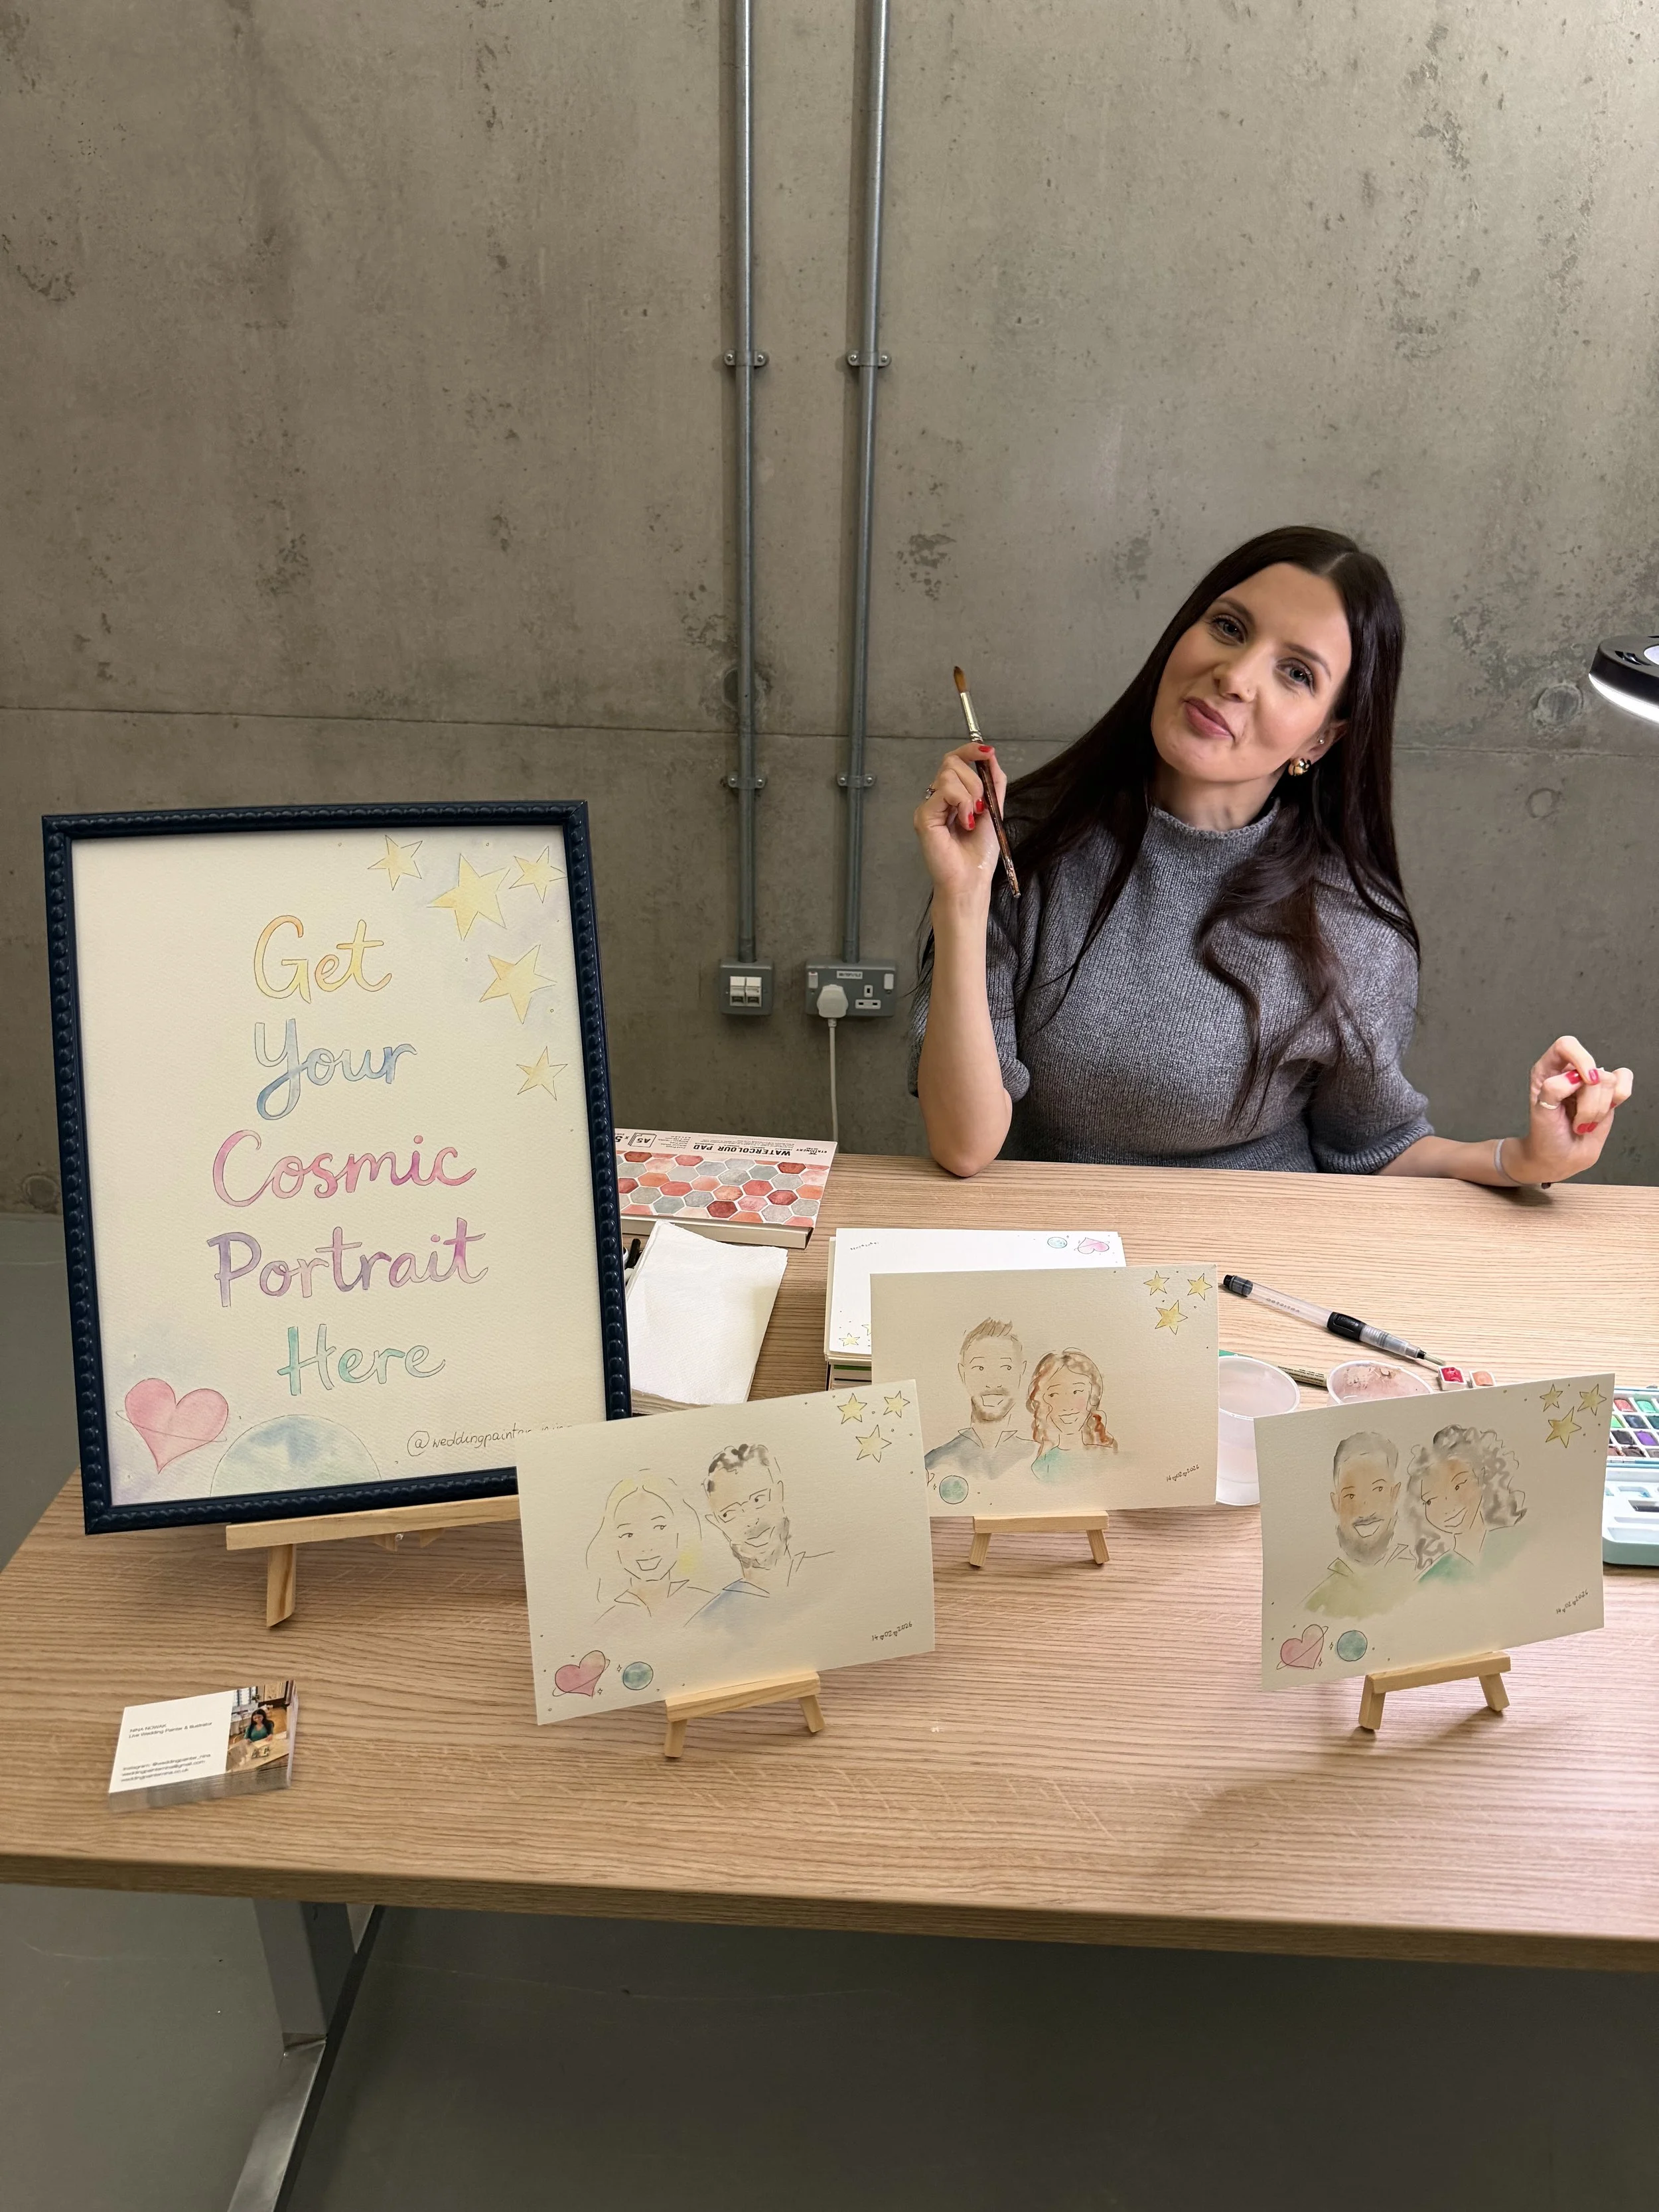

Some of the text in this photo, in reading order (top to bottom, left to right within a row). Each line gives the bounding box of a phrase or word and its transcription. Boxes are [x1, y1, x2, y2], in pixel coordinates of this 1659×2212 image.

[253, 915, 392, 1003] Get
[254, 1018, 417, 1120] Your
[212, 1129, 477, 1207] Cosmic
[717, 1145, 790, 1156] WATERCOLOUR
[208, 1217, 488, 1307] Portrait
[277, 1323, 446, 1396] Here
